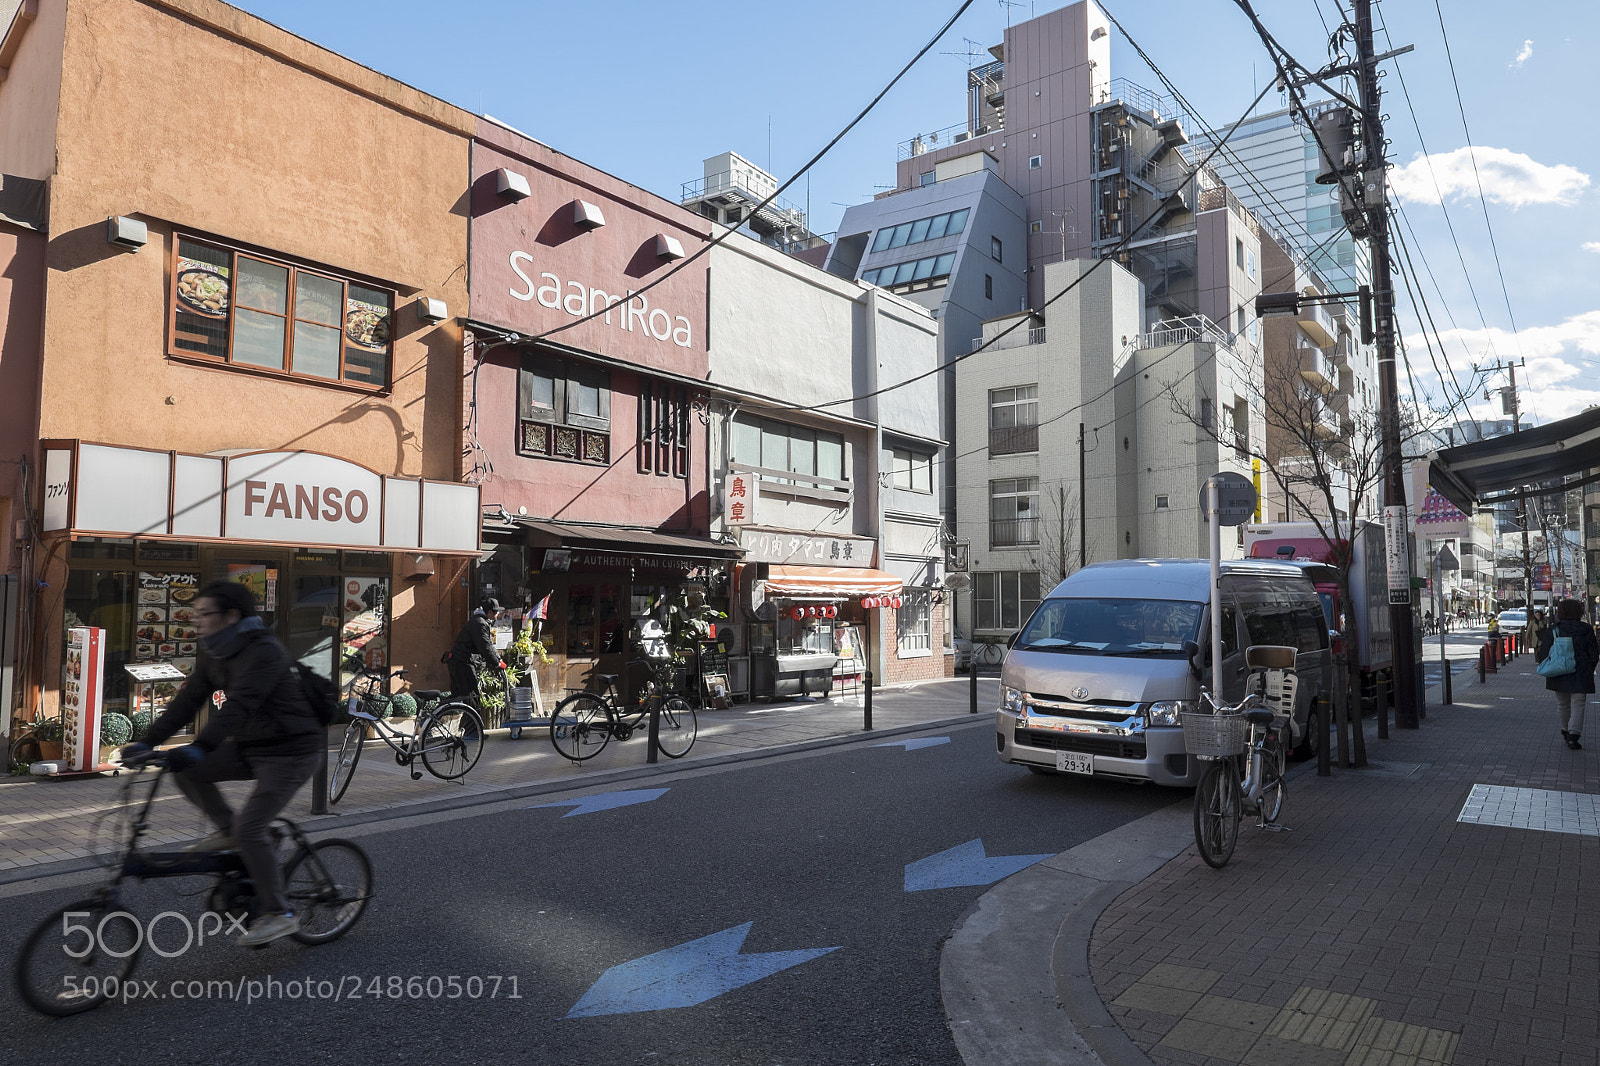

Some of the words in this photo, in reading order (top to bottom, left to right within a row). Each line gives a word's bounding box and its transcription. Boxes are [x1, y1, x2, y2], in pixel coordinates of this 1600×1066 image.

[508, 249, 693, 349] SaamRoa
[243, 479, 370, 524] FANSO
[729, 475, 747, 523] 鳥章
[746, 534, 783, 557] とり肉
[787, 536, 828, 560] タマゴ
[829, 539, 854, 561] 鳥章
[583, 554, 635, 568] AUTHENTIC
[639, 557, 660, 569] THAI
[141, 573, 198, 585] テークアウト
[1064, 760, 1091, 773] 29-34
